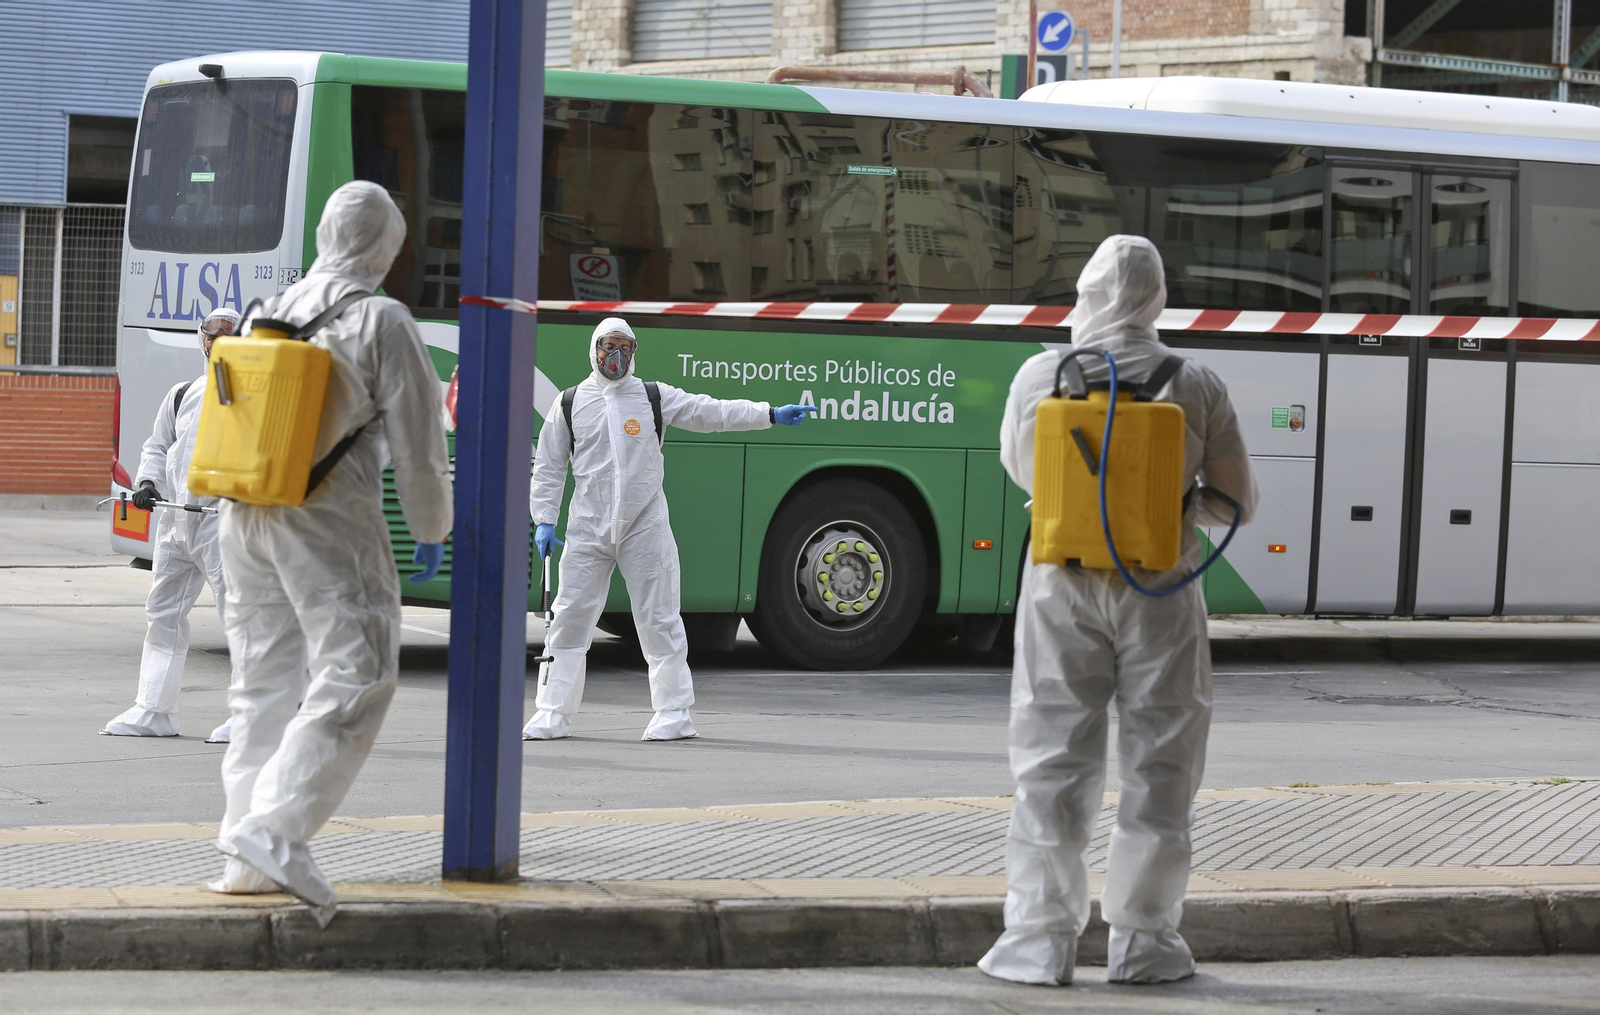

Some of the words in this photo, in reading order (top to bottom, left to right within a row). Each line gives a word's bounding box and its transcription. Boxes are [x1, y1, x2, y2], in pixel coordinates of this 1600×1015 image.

[130, 261, 145, 275] 3123
[254, 265, 273, 280] 3123
[146, 261, 243, 321] ALSA
[677, 353, 818, 386] Transportes
[825, 359, 921, 386] Públicos
[927, 363, 956, 387] de
[798, 389, 956, 424] Andalucía
